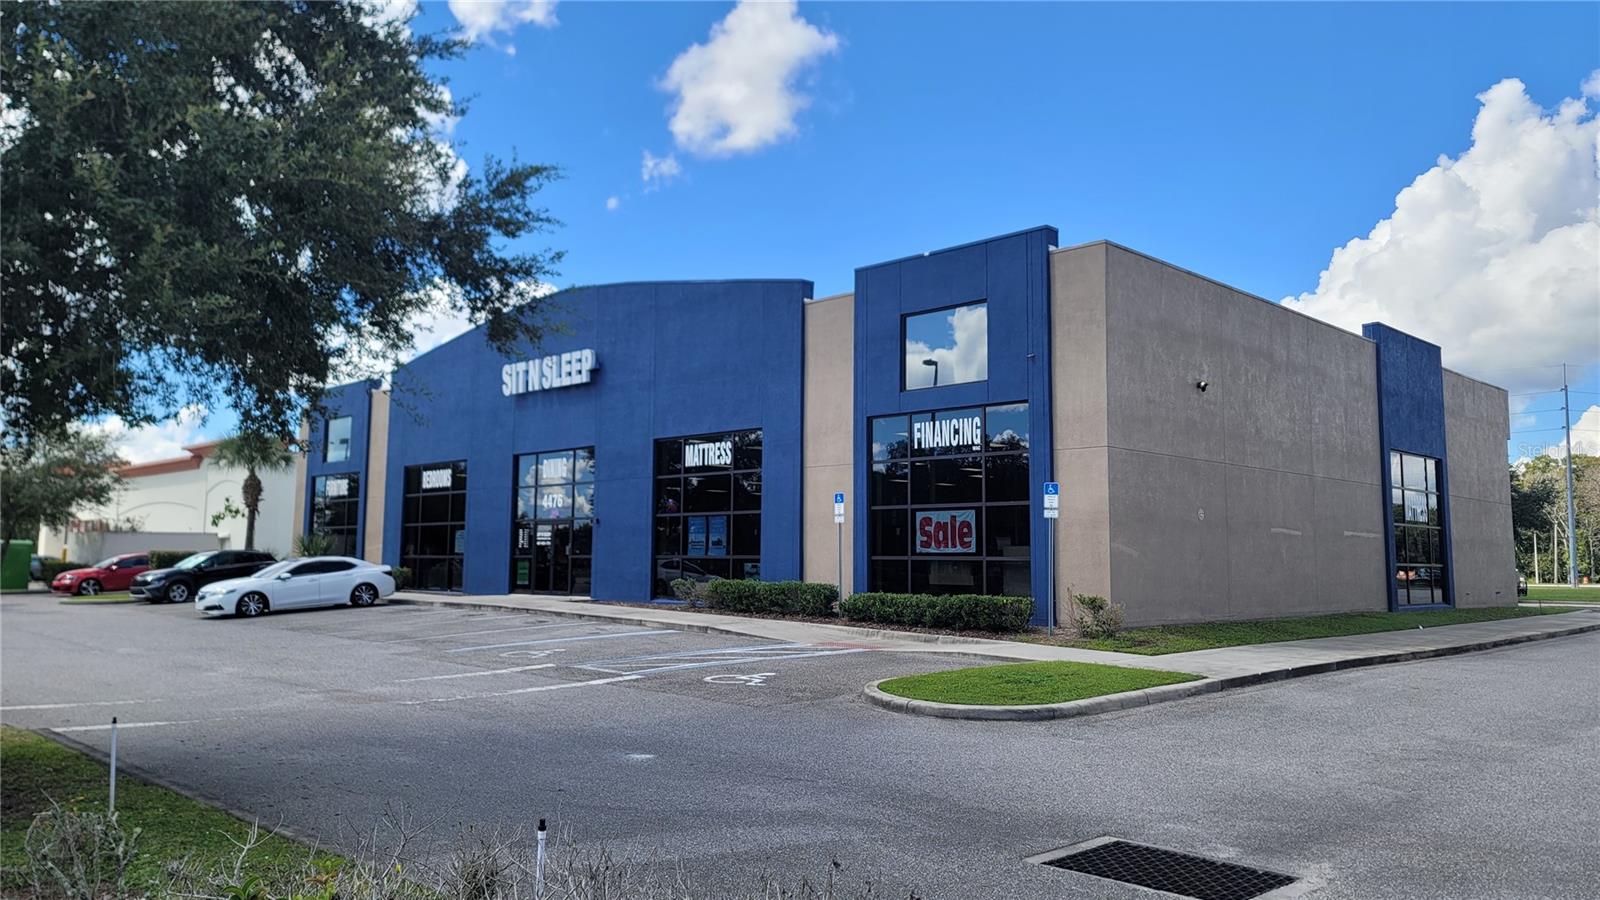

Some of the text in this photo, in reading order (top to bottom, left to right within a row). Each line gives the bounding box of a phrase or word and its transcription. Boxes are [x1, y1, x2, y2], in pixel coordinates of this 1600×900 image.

[502, 349, 596, 397] SIT N SLEEP
[914, 416, 981, 449] FINANCING
[685, 441, 732, 467] MATTRESS
[542, 494, 563, 510] 4476
[919, 515, 973, 549] Sale
